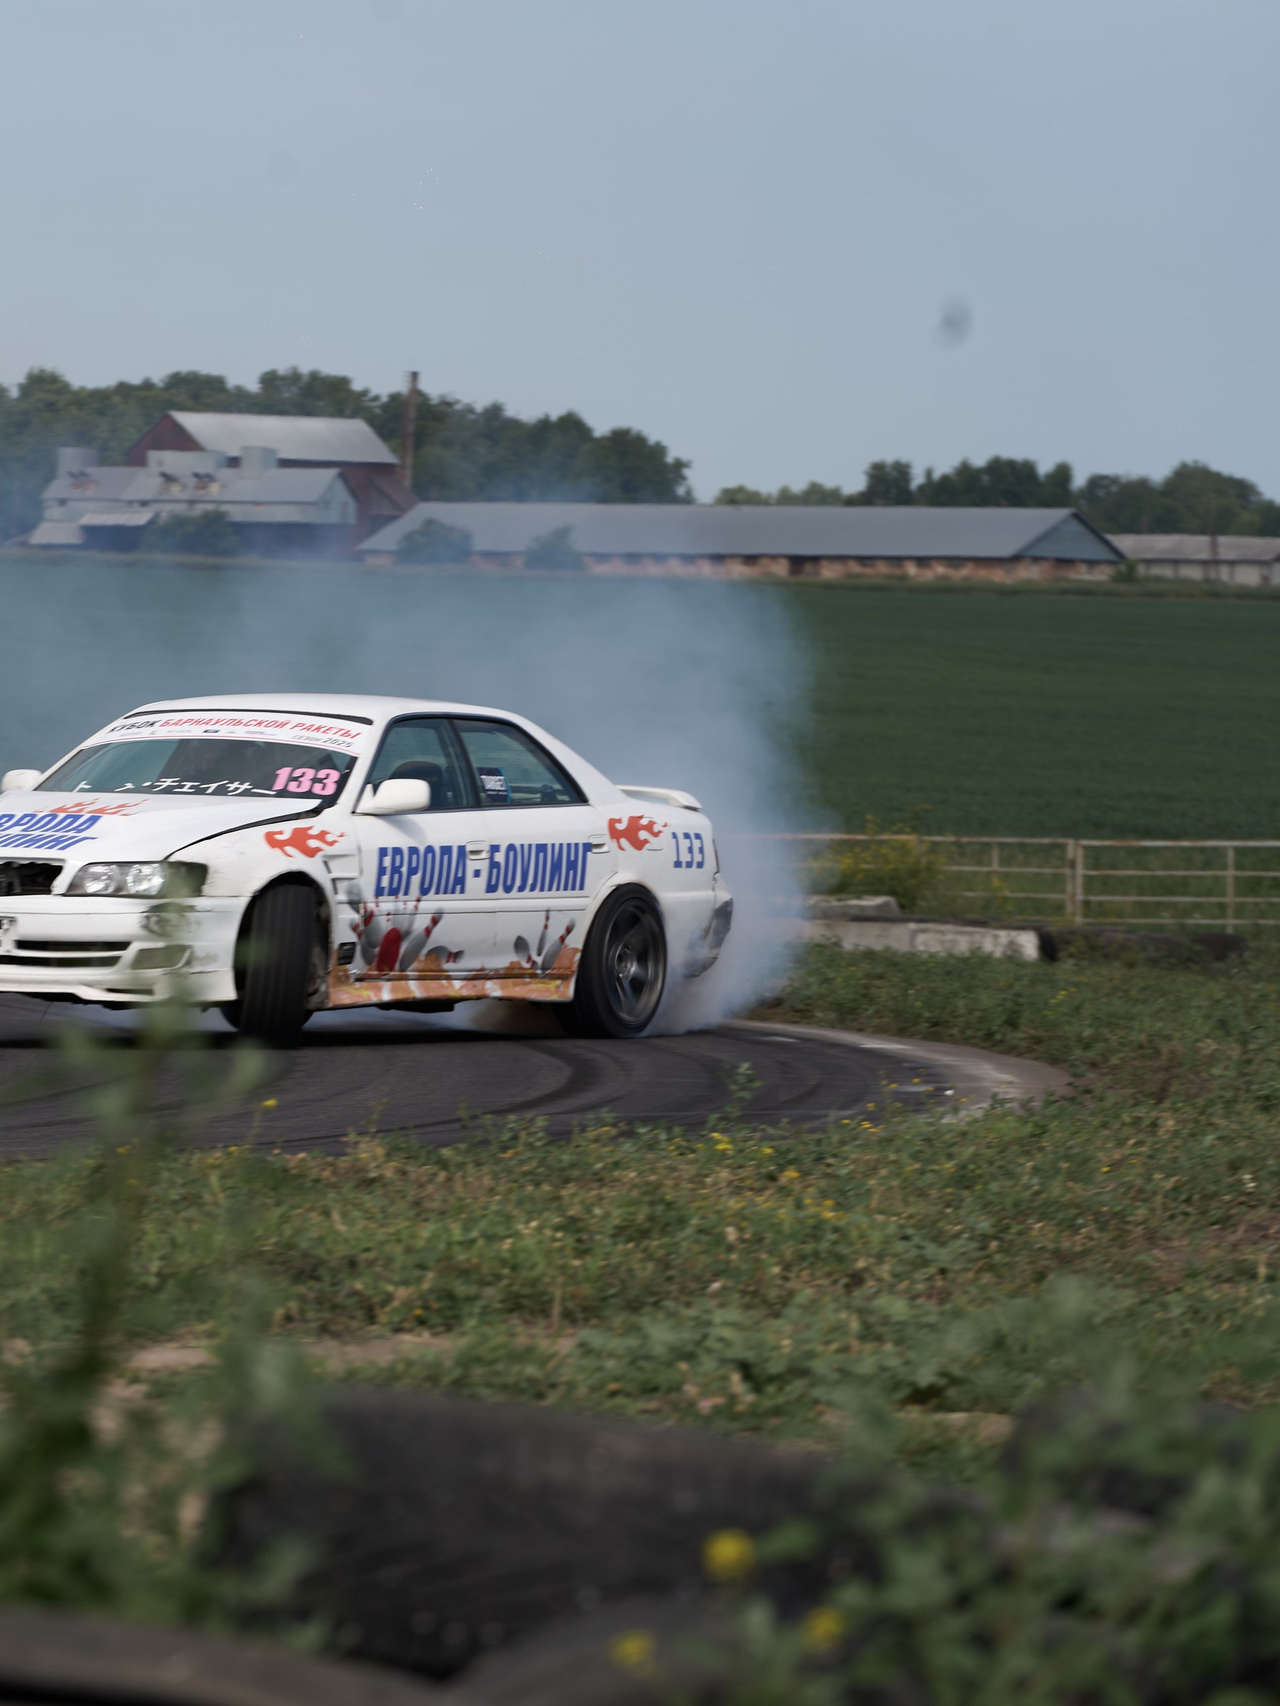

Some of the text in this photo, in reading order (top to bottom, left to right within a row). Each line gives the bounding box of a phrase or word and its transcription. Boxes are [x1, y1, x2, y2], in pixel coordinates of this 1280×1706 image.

[107, 719, 161, 733] КУБОК
[159, 717, 291, 730] БАРНАУЛЬСКОЙ
[290, 722, 362, 739] РАКЕТЫ
[322, 738, 354, 748] 2025
[272, 766, 341, 796] 133
[671, 831, 705, 869] 133
